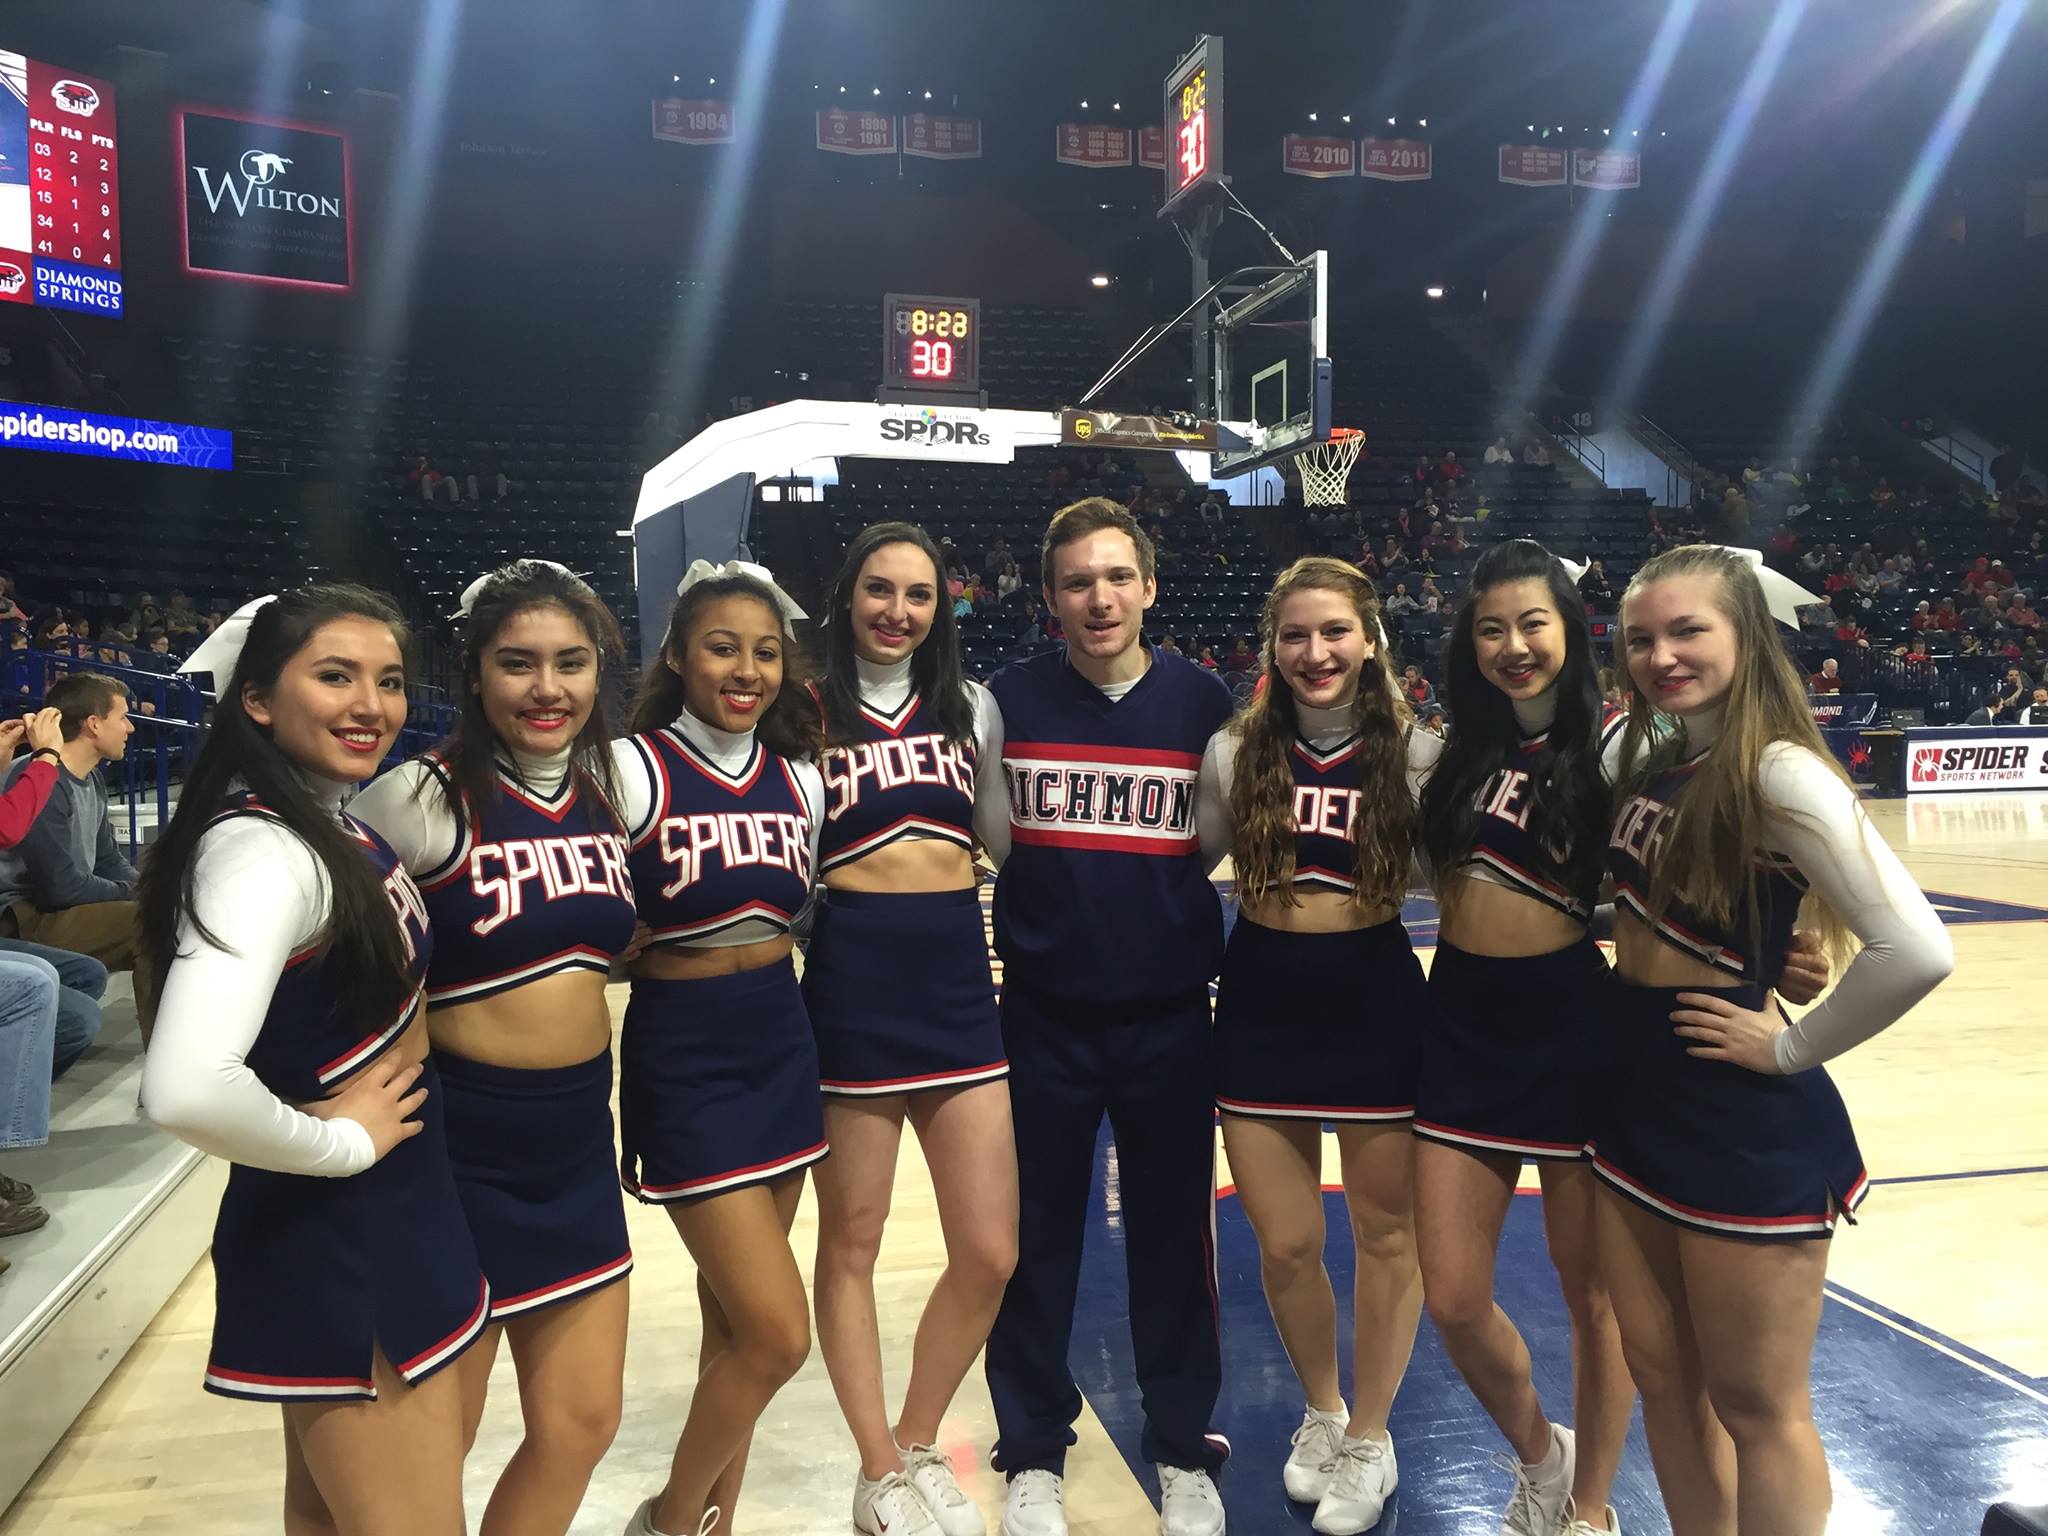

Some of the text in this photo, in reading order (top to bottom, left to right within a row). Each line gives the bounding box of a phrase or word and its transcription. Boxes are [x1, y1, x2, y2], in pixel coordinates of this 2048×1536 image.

[30, 118, 114, 149] PLR FLS PTS
[687, 112, 728, 131] 1984
[34, 142, 108, 171] 03 2 2
[1313, 146, 1349, 165] 2010
[1391, 150, 1426, 168] 2011
[36, 167, 109, 194] 12 1 3
[37, 190, 110, 217] 15 1 9
[37, 214, 110, 240] 34 1 4
[38, 240, 111, 265] 41 0 4
[36, 266, 122, 295] DIAMOND
[39, 283, 120, 309] SPRINGS
[913, 340, 951, 376] 30
[0, 411, 179, 454] pidershop.com
[1572, 412, 1592, 427] 18
[1942, 746, 2029, 771] SPIDER
[821, 733, 977, 822] SPIDERS
[1940, 771, 2024, 782] SPORTS NETWORK
[1014, 767, 1196, 833] ICHMON
[660, 812, 811, 900] SPIDERS
[469, 833, 637, 938] SPIDERS
